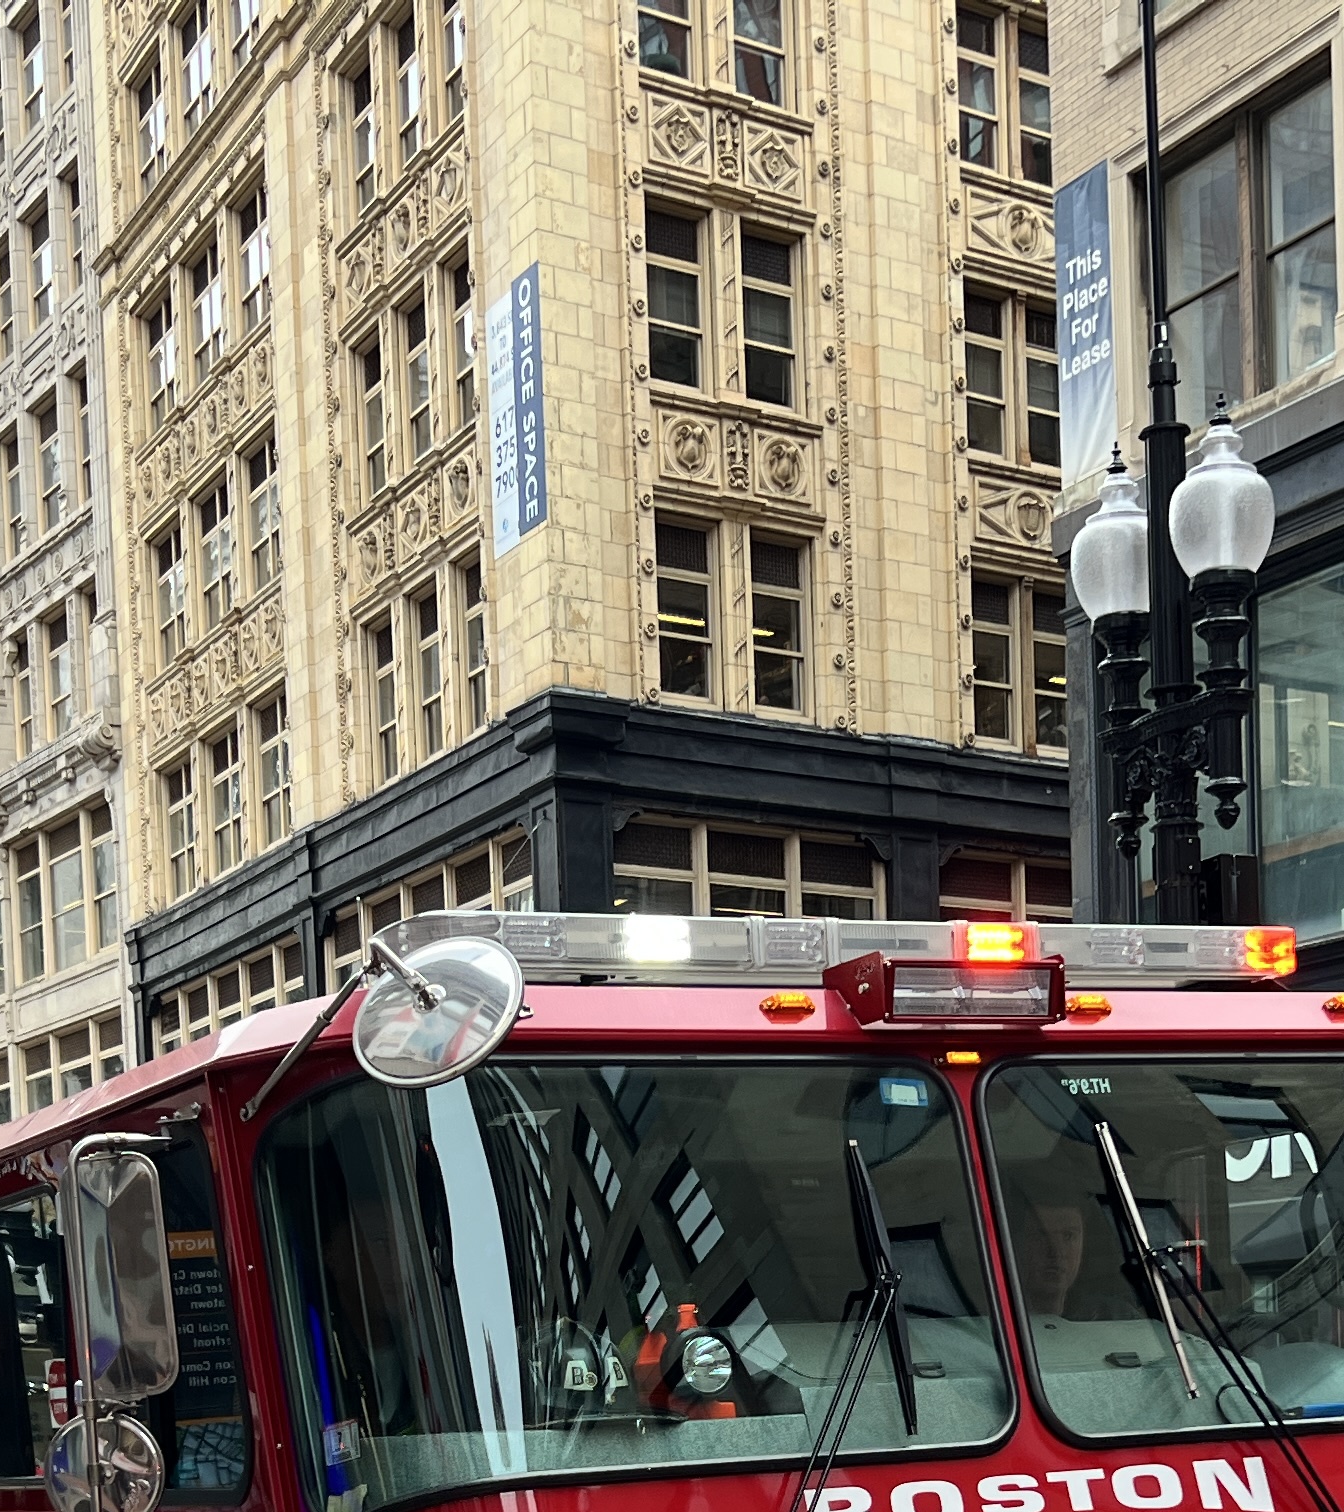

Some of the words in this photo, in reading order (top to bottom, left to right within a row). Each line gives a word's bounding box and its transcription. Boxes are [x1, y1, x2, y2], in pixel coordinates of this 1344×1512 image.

[1065, 248, 1102, 285] This
[1063, 275, 1108, 319] Place
[518, 277, 535, 404] OFFICE
[1070, 312, 1099, 345] For
[1061, 338, 1111, 381] Lease
[495, 404, 515, 438] 617
[496, 435, 516, 467] 375
[523, 410, 539, 523] SPACE
